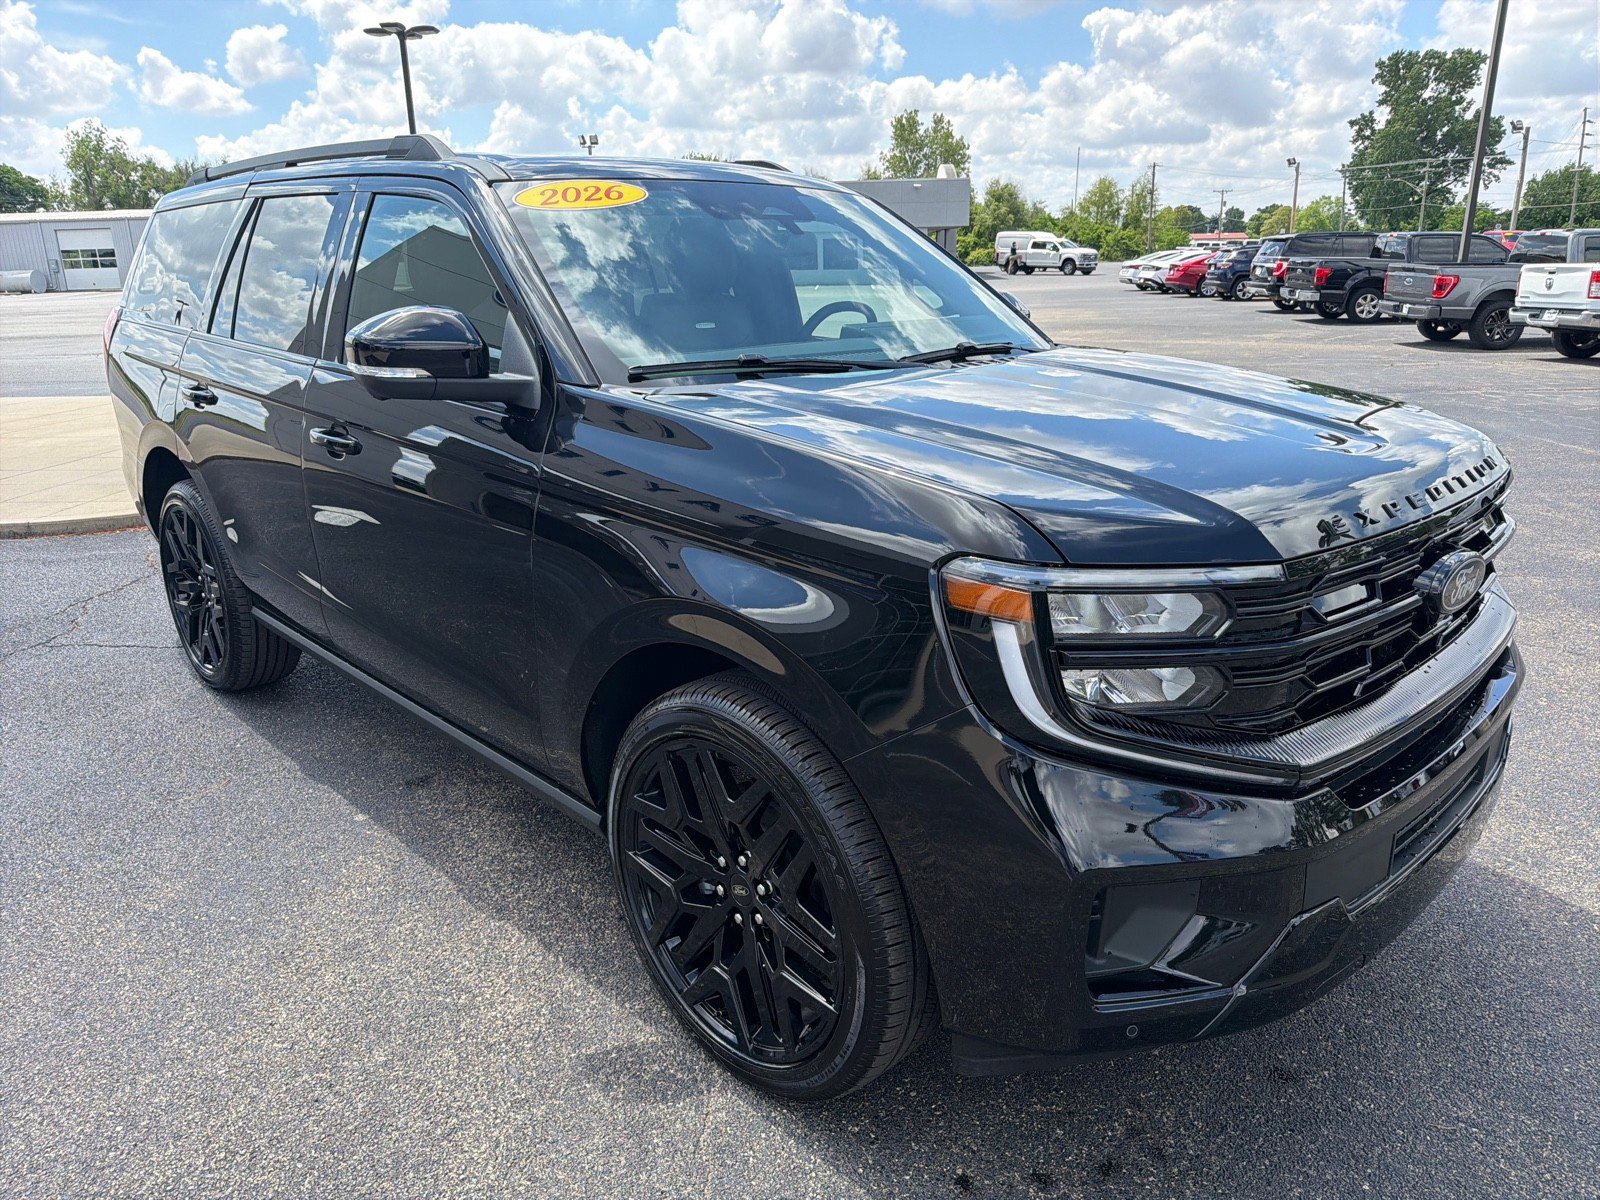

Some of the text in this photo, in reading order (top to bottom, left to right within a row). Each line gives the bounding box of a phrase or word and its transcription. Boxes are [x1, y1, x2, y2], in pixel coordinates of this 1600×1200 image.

[540, 185, 623, 205] 2026
[1317, 456, 1498, 538] EXPEDITION
[1449, 563, 1482, 605] Ford
